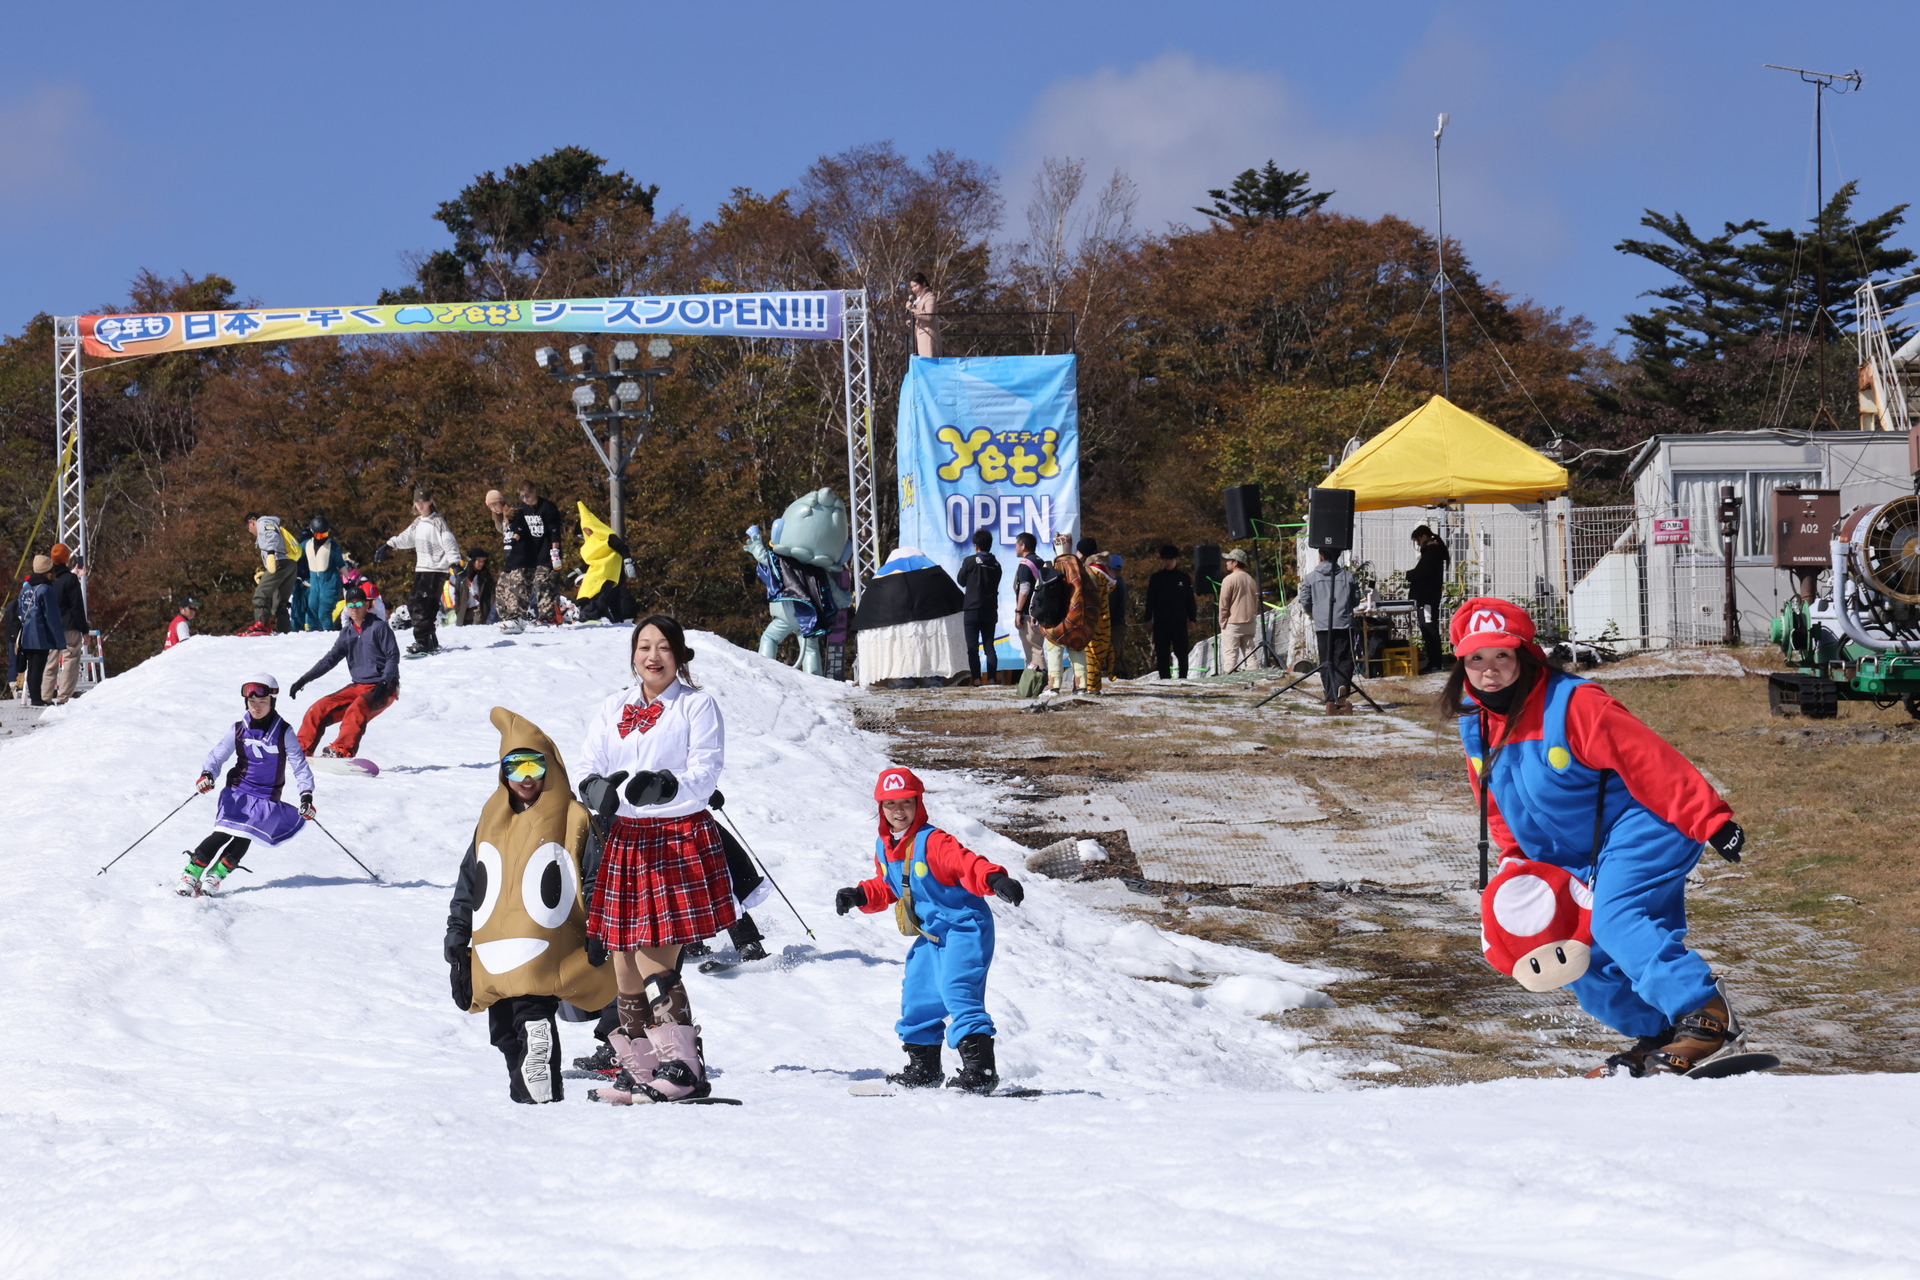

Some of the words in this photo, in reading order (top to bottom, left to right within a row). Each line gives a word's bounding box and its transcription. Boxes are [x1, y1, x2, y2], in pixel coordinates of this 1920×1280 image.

[101, 317, 164, 340] 今年も
[936, 426, 1061, 486] Yeti
[946, 494, 1050, 545] OPEN
[1800, 523, 1819, 534] A02
[1474, 612, 1503, 632] M
[885, 776, 903, 789] M
